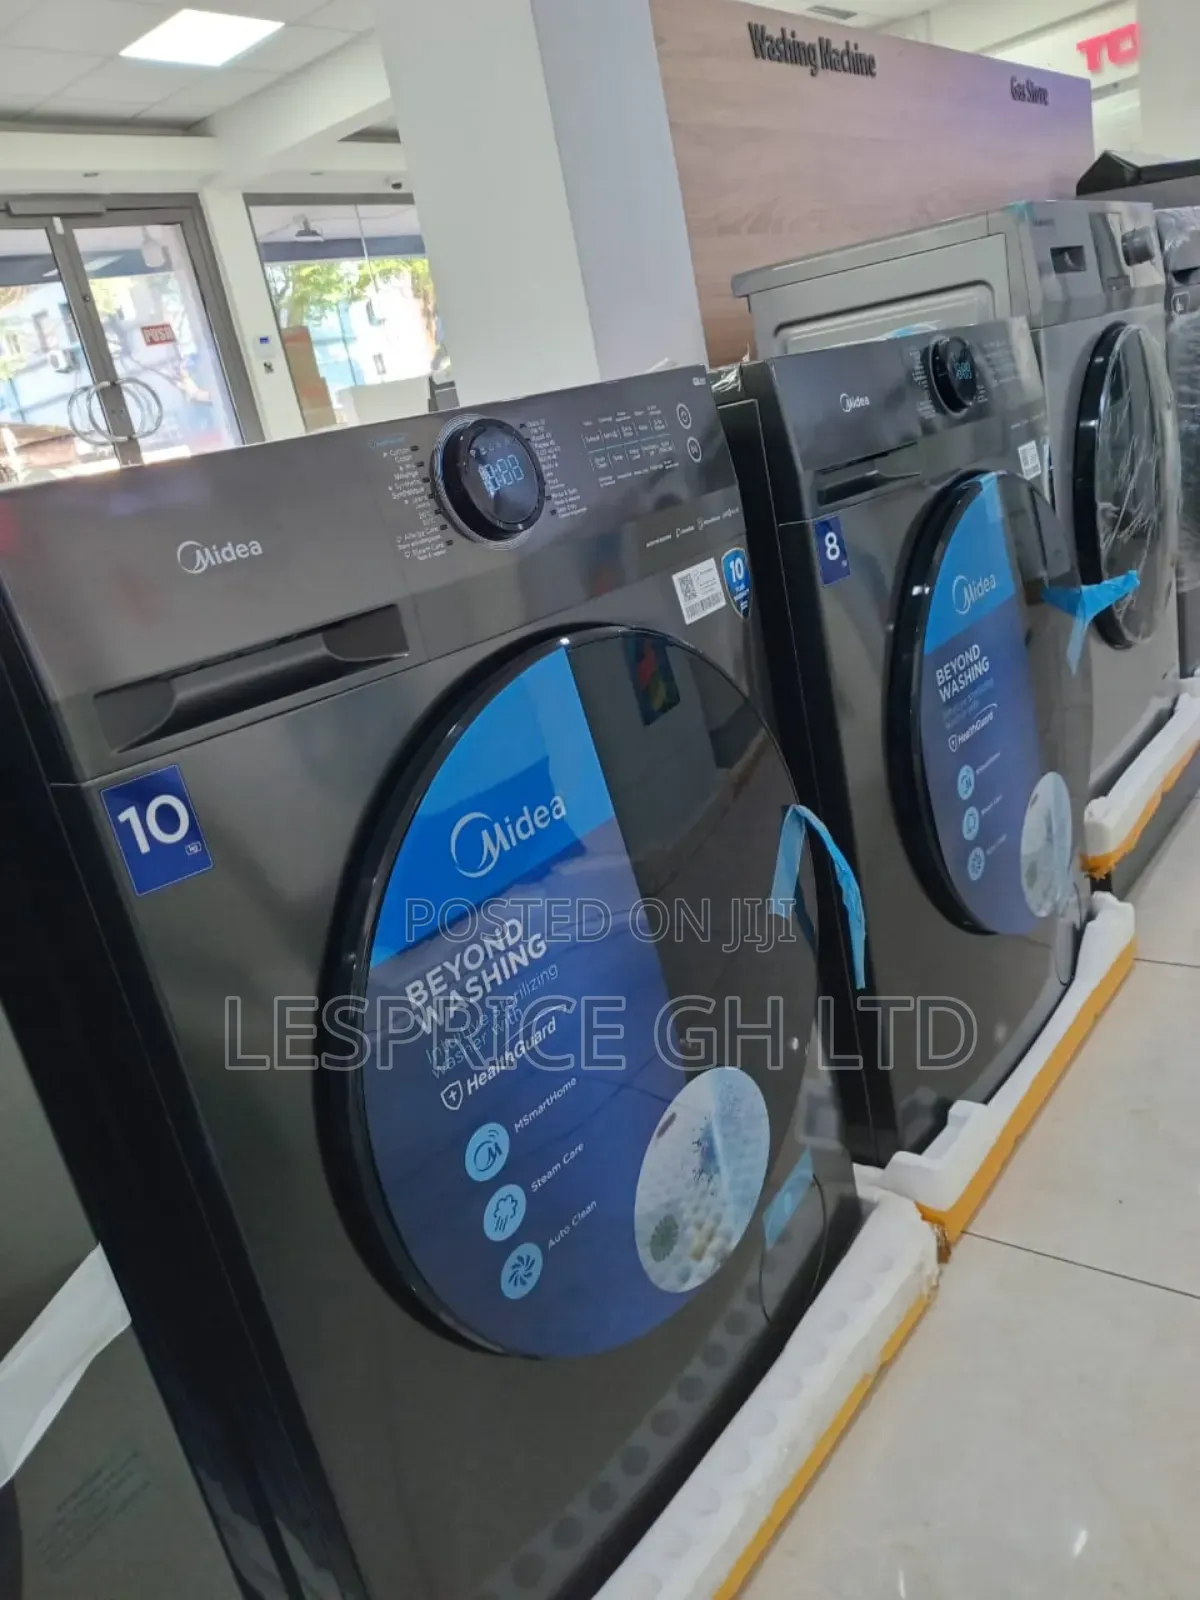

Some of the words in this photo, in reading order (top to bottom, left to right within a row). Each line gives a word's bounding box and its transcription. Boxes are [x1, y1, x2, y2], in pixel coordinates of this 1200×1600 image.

[748, 21, 819, 77] Washing
[818, 36, 876, 78] Machine
[839, 393, 869, 412] Midea
[177, 540, 263, 574] Midea
[729, 557, 745, 583] 10
[825, 531, 840, 560] 8
[952, 573, 996, 615] Midea
[936, 644, 980, 687] BEYOND
[938, 656, 990, 703] WASHING
[118, 794, 190, 854] 10
[450, 795, 567, 878] Midea
[406, 917, 522, 1010] BEYOND
[414, 932, 548, 1035] WASHING
[466, 1016, 557, 1096] HealthGuard
[514, 1077, 577, 1134] MSmartHome
[530, 1162, 562, 1193] Steam
[562, 1142, 585, 1168] Care
[547, 1225, 571, 1250] Auto
[571, 1200, 598, 1227] Clean
